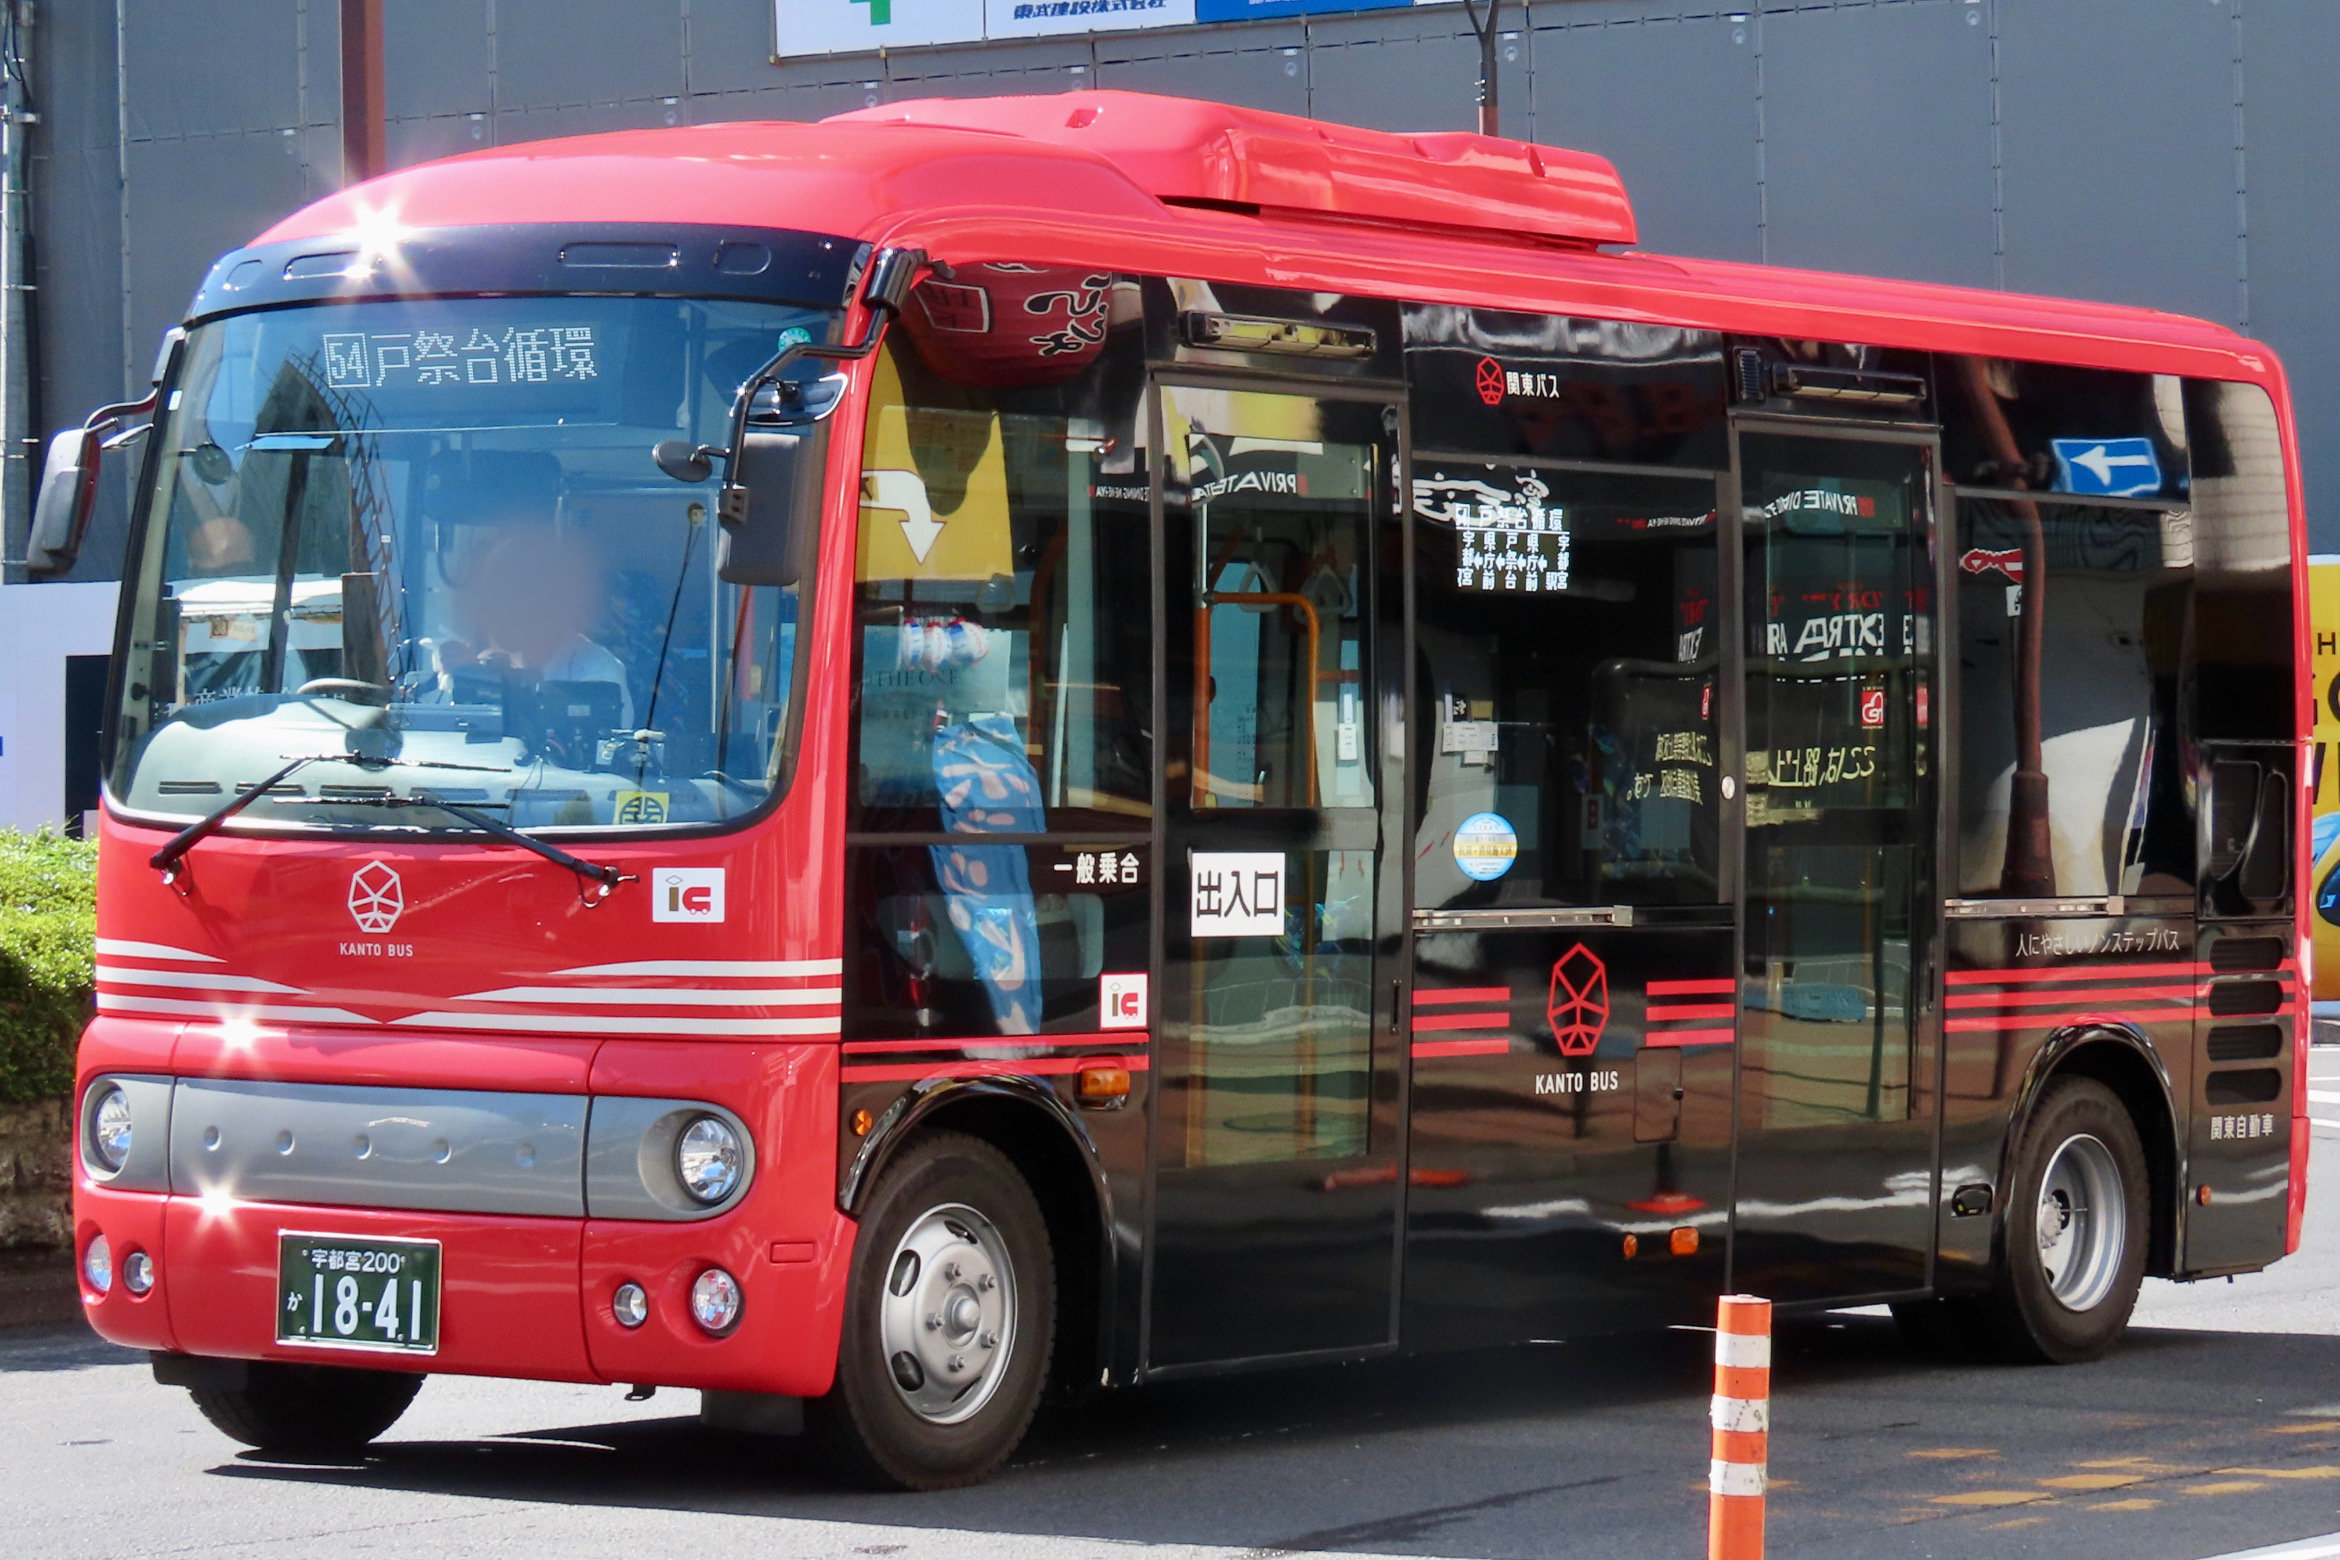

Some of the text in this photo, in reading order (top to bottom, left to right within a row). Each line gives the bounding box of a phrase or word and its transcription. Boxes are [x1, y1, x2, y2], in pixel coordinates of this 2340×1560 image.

[328, 326, 598, 387] 54 戸祭台循環
[1505, 371, 1560, 398] 関東バス
[1053, 852, 1140, 884] 一般乗合
[1196, 870, 1279, 918] 出入口
[340, 942, 414, 957] KANTO BUS
[2015, 928, 2180, 957] 人にやさしいノンステップバス
[1535, 1070, 1618, 1094] KANTO BUS
[2210, 1113, 2274, 1140] 関東自動車
[286, 1272, 422, 1341] か 18-41
